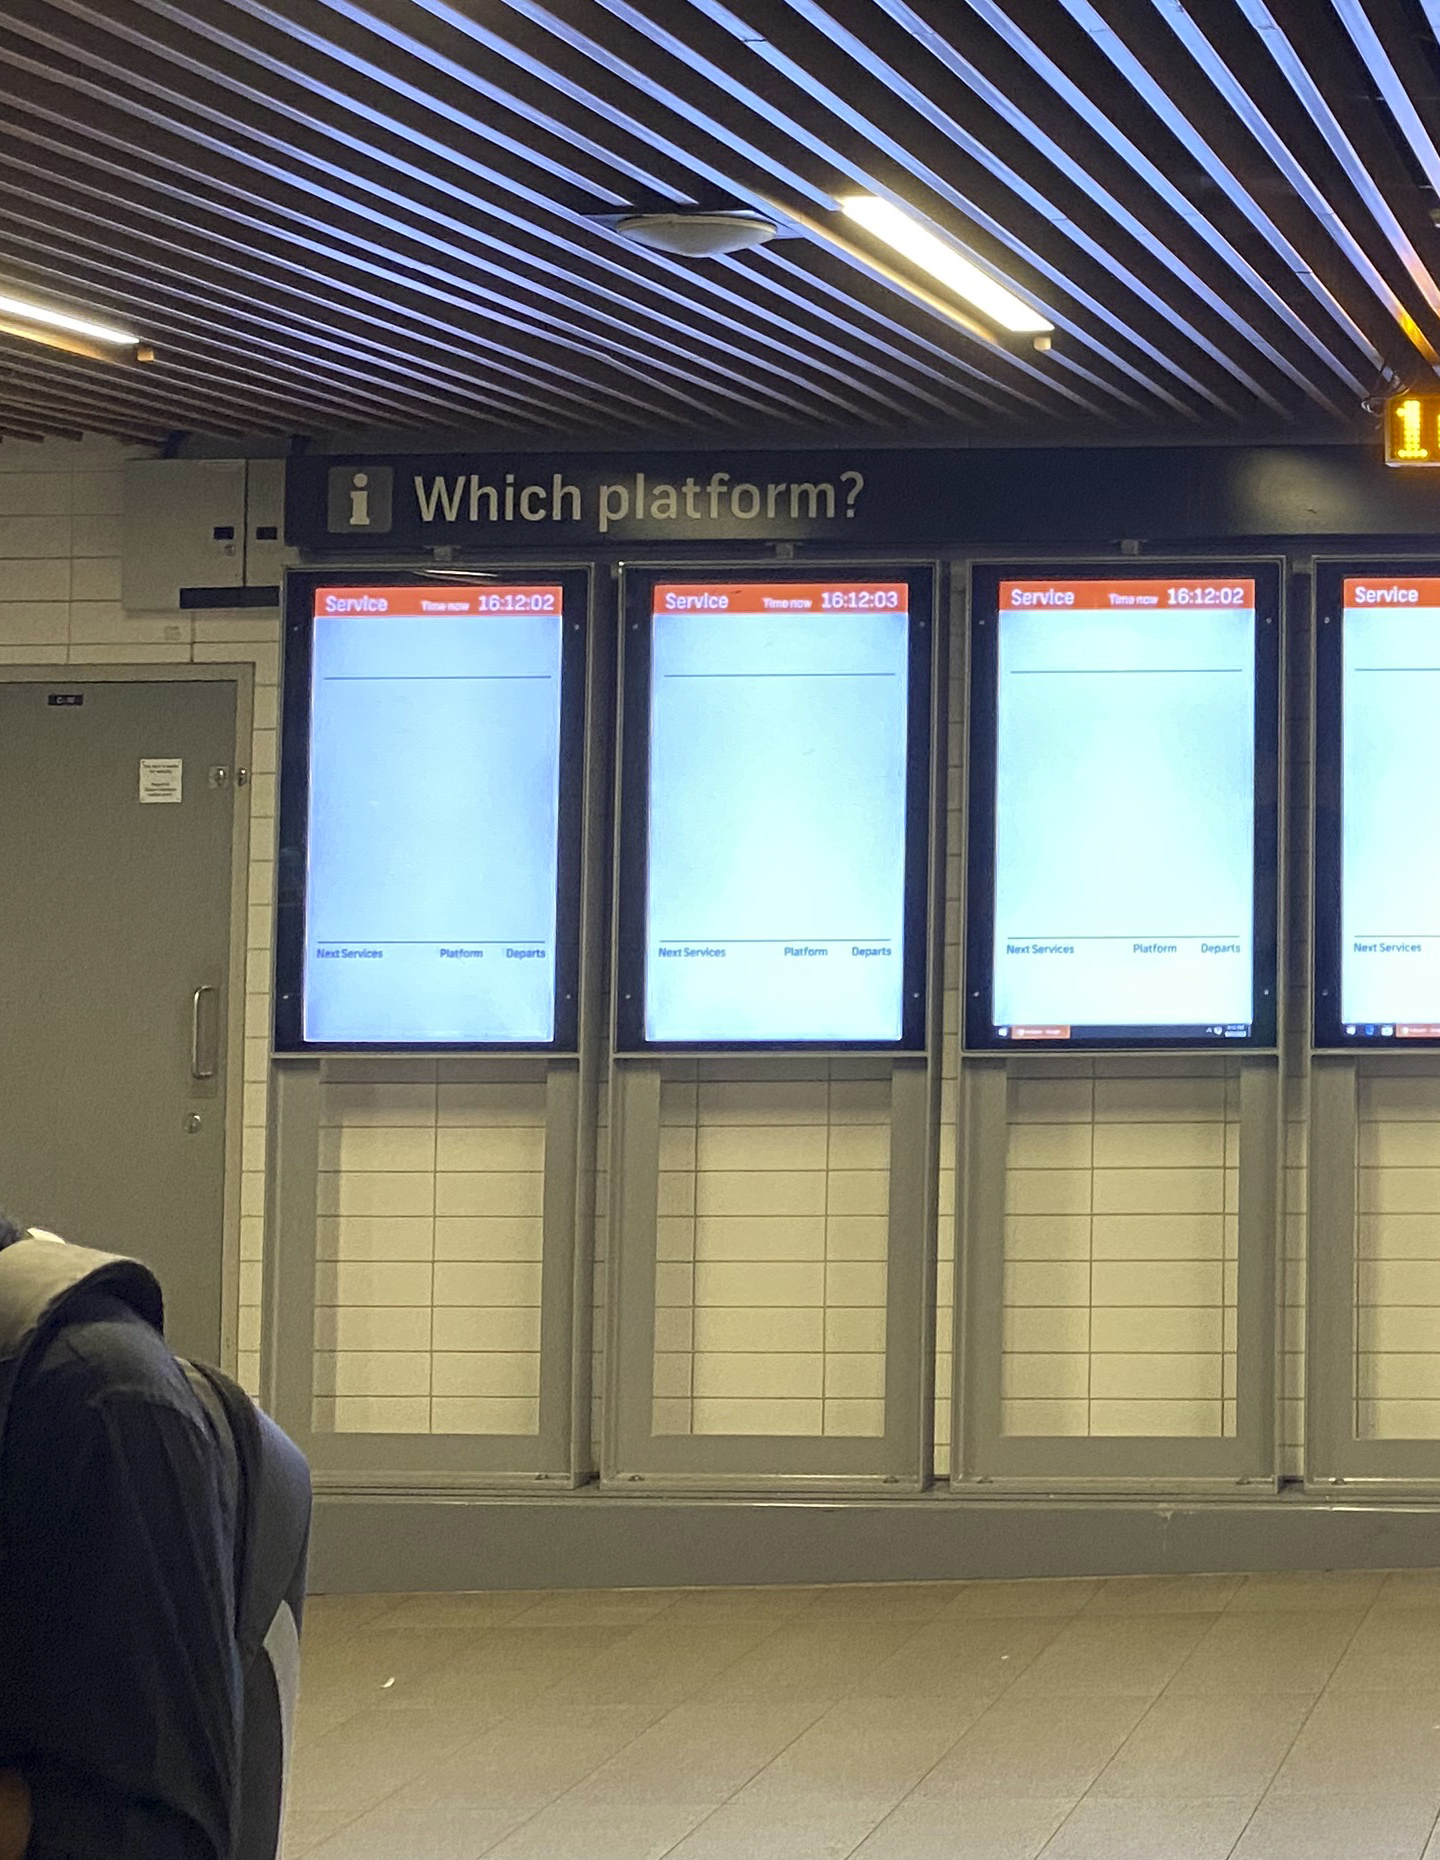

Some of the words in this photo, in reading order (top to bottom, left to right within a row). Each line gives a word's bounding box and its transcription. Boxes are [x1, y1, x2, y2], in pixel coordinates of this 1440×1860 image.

[414, 473, 582, 522] Which
[600, 471, 865, 532] platform?
[421, 601, 446, 611] Time
[447, 602, 470, 611] now
[478, 594, 554, 611] 16:12:02
[665, 592, 728, 609] Service
[763, 598, 789, 608] Time
[790, 599, 812, 608] now
[821, 591, 897, 608] 16:12:03
[1011, 588, 1075, 605] Service
[1109, 593, 1135, 605] Time
[1136, 595, 1158, 605] now
[1167, 588, 1244, 605] 16:12:02
[1355, 586, 1418, 603] Service
[326, 595, 388, 612] Service
[317, 949, 340, 958] Next
[341, 949, 383, 958] Services
[440, 949, 483, 958] Platform
[506, 949, 545, 960] Departs
[658, 947, 682, 957] Next
[684, 947, 726, 957] Services
[784, 947, 828, 956] Platform
[852, 947, 891, 957] Departs
[1007, 944, 1030, 954] Next
[1032, 945, 1074, 954] Services
[1133, 944, 1177, 953] Platform
[1201, 944, 1240, 955] Departs
[1354, 943, 1377, 952] Next
[1379, 943, 1421, 952] Services
